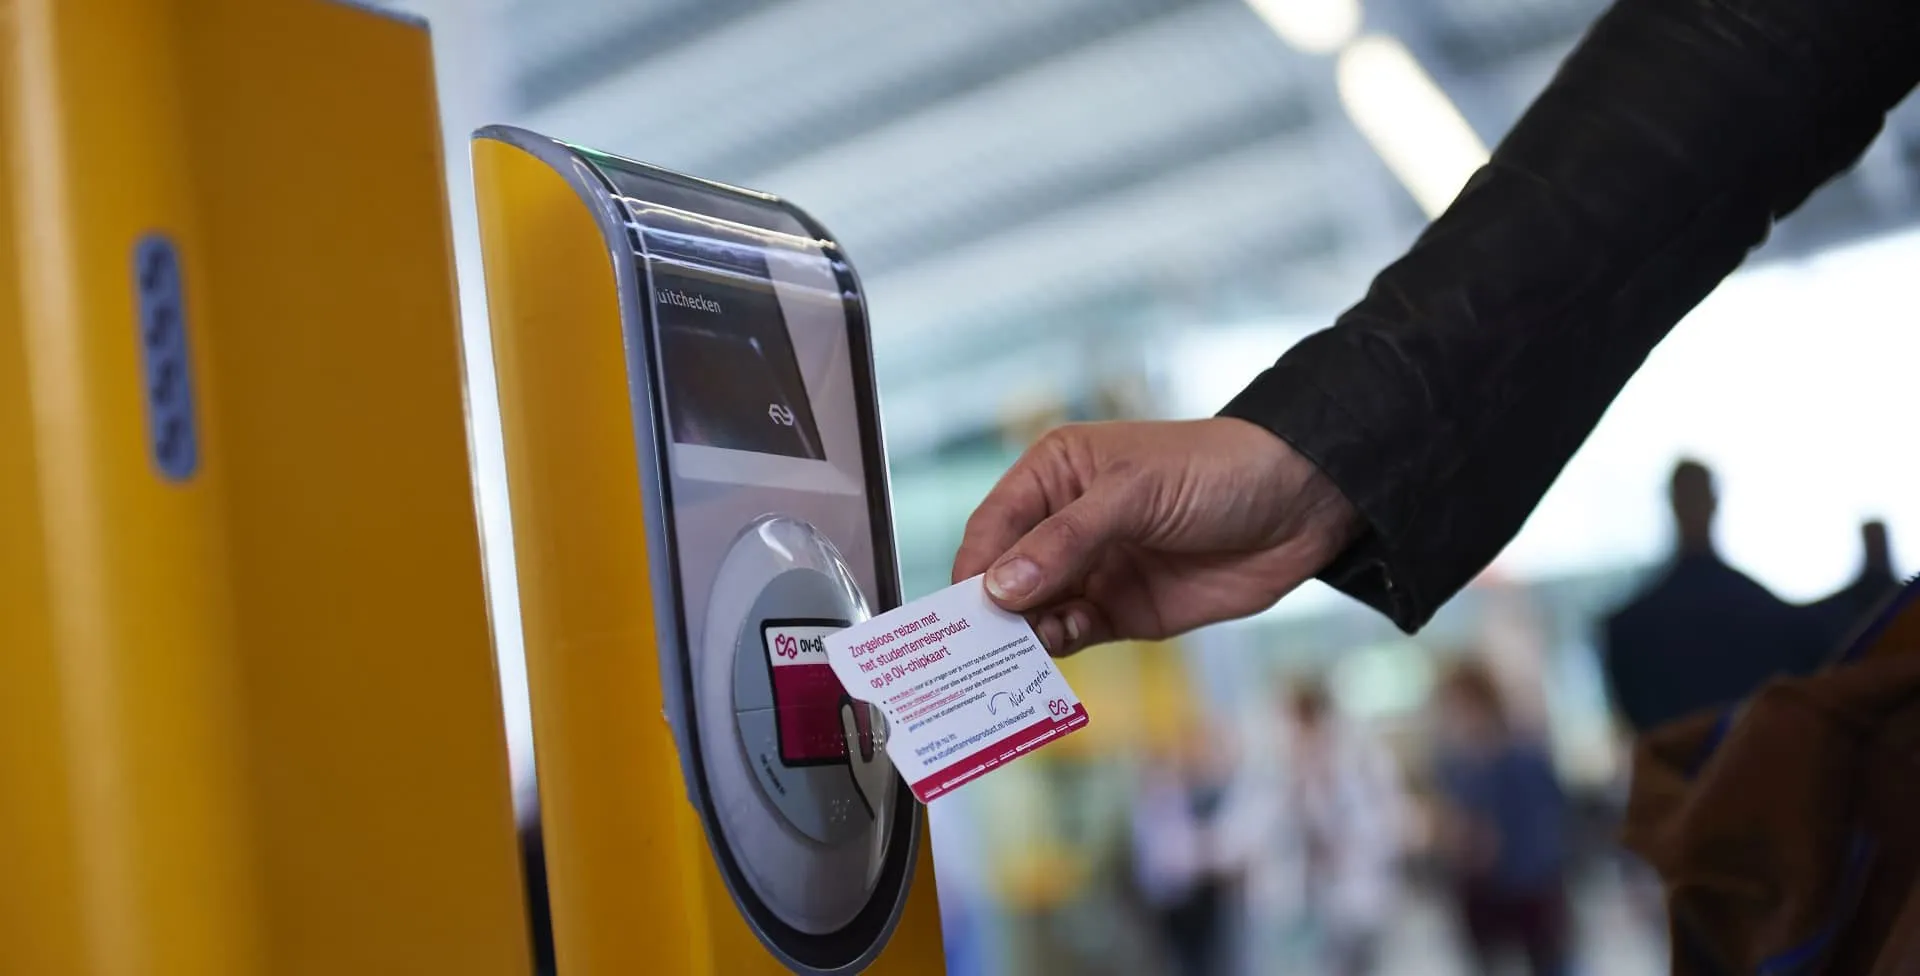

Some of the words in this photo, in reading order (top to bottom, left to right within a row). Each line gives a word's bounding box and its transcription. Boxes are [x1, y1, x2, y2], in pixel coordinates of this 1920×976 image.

[656, 289, 722, 313] uitchecken
[848, 633, 894, 658] Zorgeloos
[893, 621, 922, 638] reizen
[920, 612, 940, 627] met
[858, 658, 878, 672] het
[876, 618, 970, 666] studentenreisproduct
[870, 678, 884, 688] op
[881, 673, 893, 686] je
[891, 646, 951, 678] OV-chipkaart
